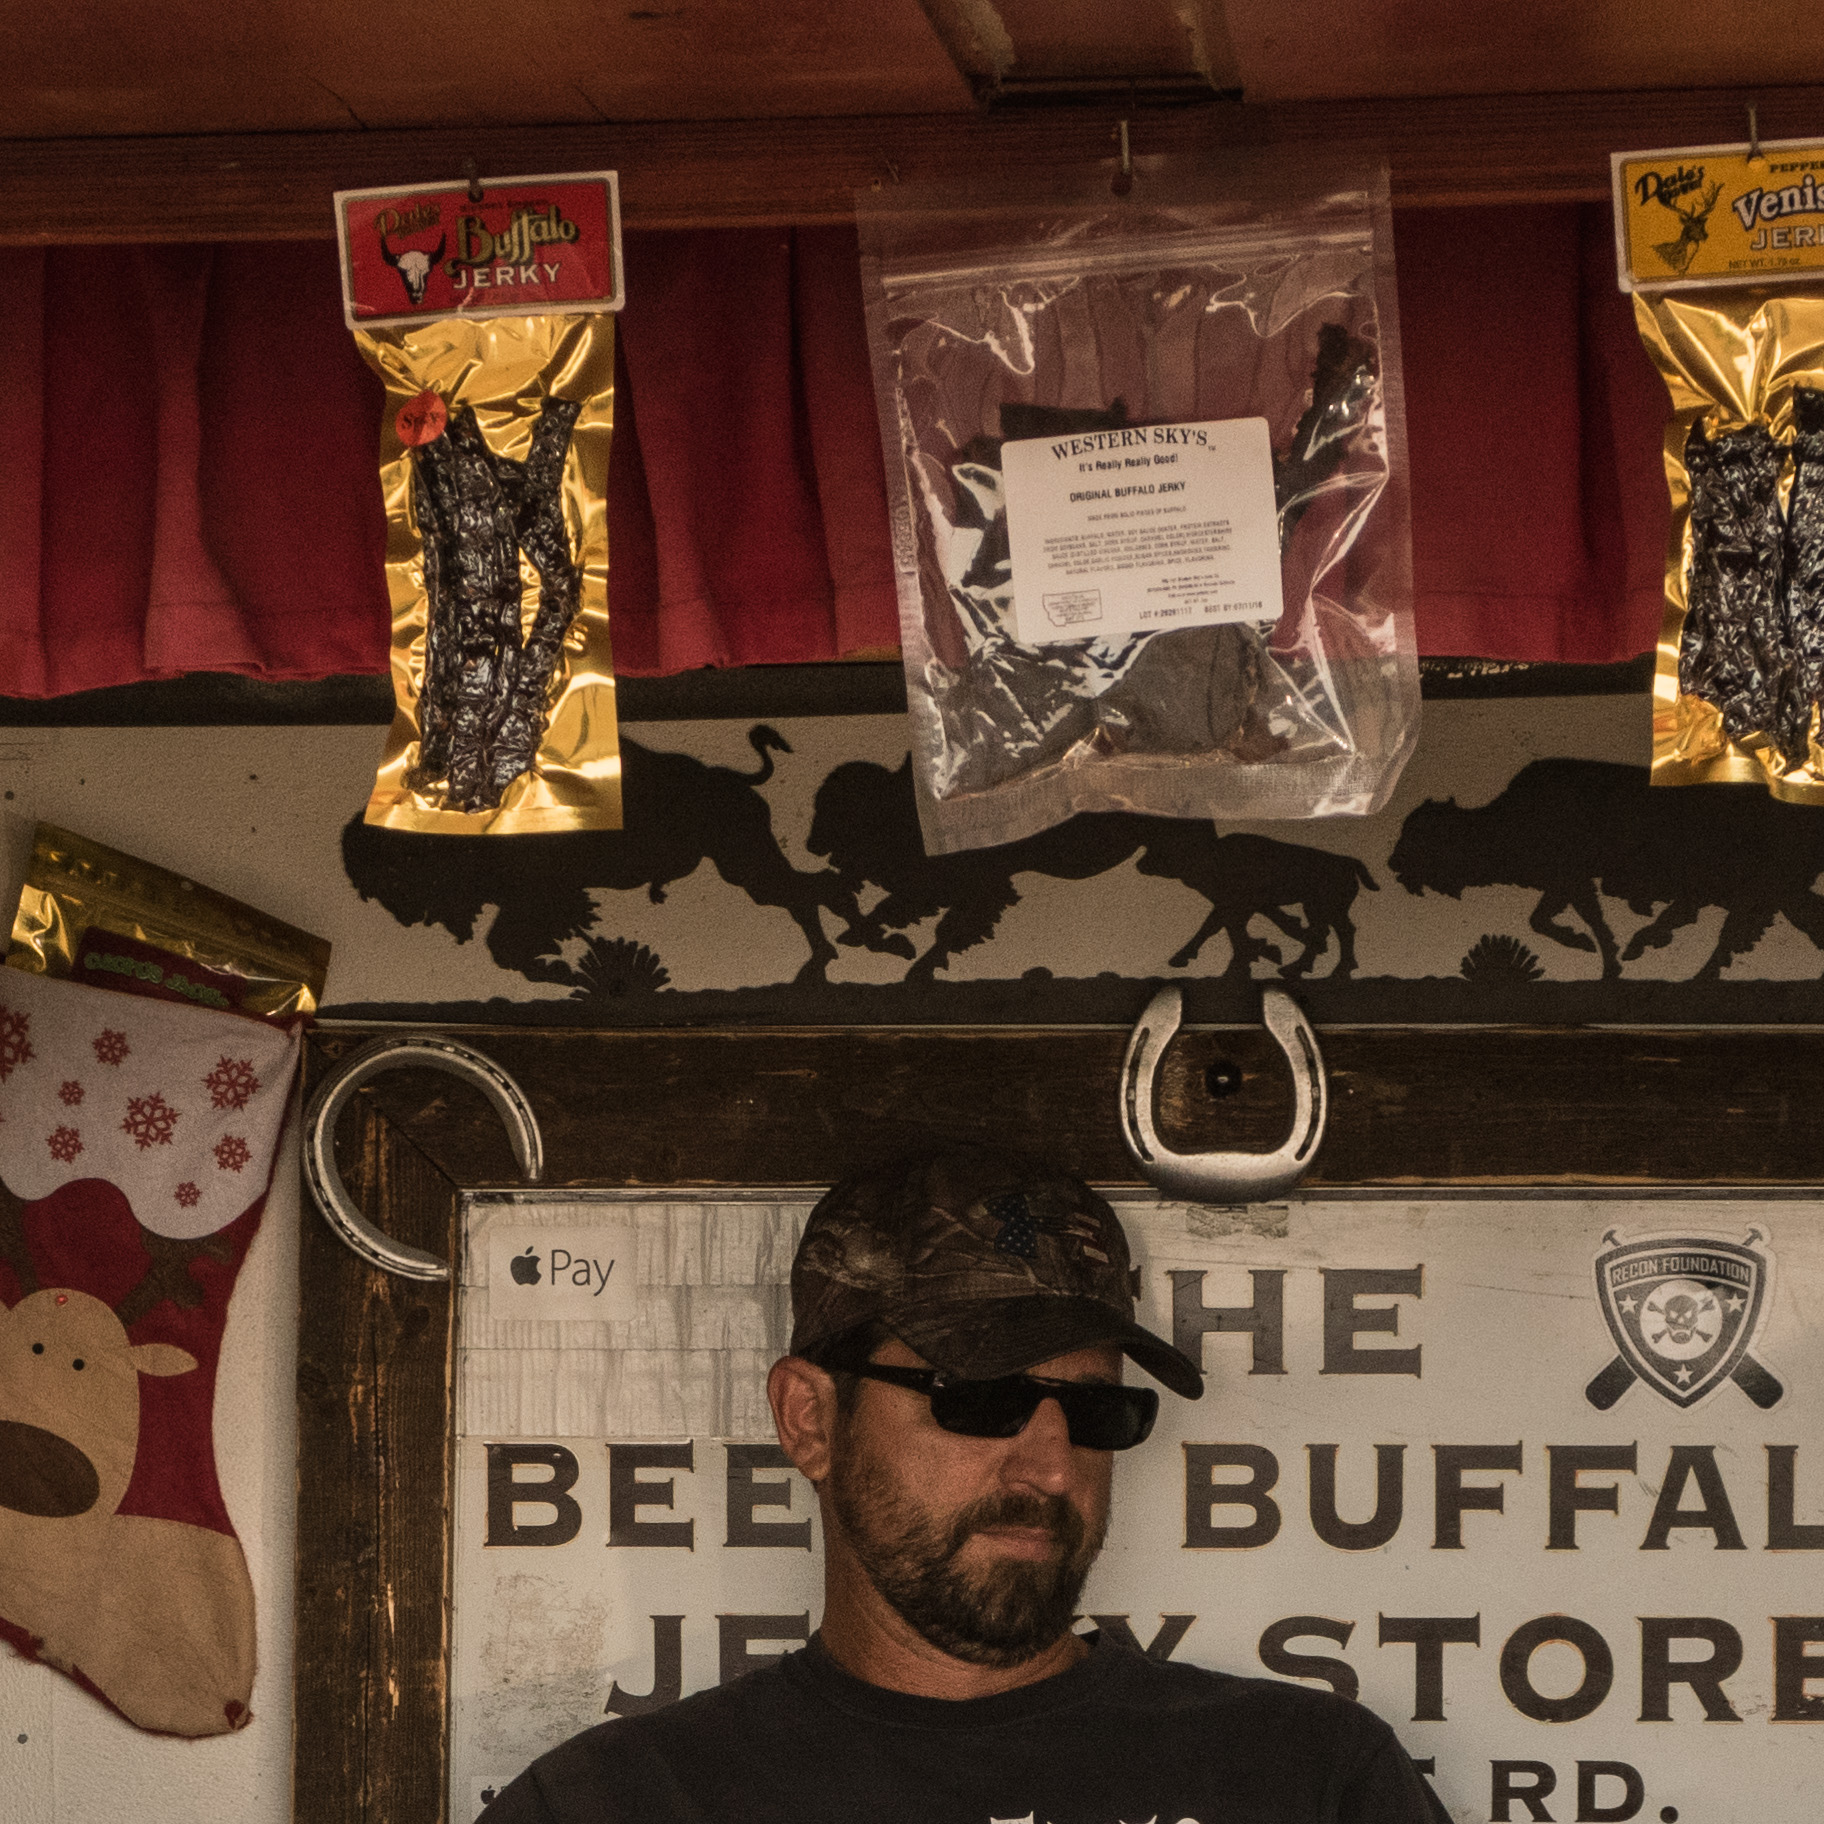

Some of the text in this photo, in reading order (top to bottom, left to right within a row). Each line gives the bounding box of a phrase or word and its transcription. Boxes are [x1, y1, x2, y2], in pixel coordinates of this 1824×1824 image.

[443, 205, 579, 277] Buffalo
[453, 263, 560, 289] JERKY
[1051, 427, 1208, 461] WESTERN SKY'S
[1079, 461, 1093, 473] It's
[1095, 458, 1122, 473] Really
[1124, 455, 1151, 470] Really
[1069, 481, 1186, 502] ORIGINAL BUFFALO JERKY
[549, 1249, 615, 1297] Pay
[1612, 1256, 1750, 1283] RECON FOUNDATION
[1132, 1263, 1424, 1379] HE
[482, 1439, 814, 1553] BEE
[1487, 1758, 1680, 1824] RD.
